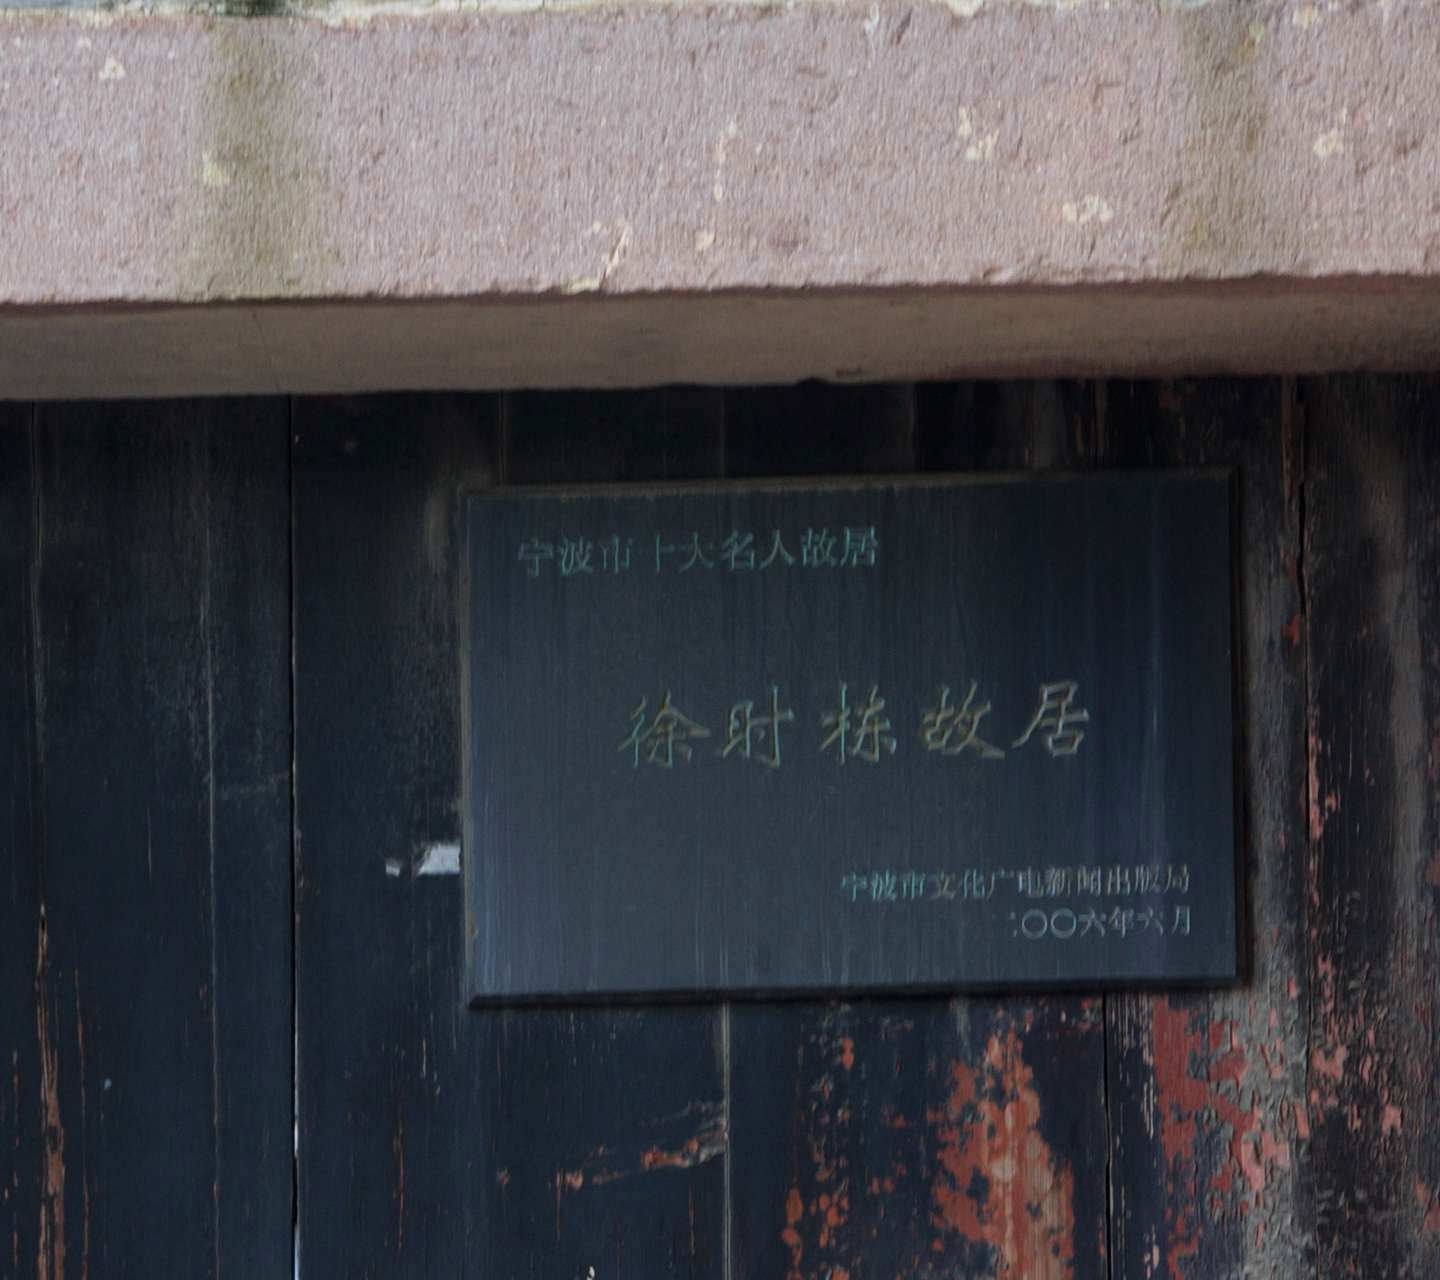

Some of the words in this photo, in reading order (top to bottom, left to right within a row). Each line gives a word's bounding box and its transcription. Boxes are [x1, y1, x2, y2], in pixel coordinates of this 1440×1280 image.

[518, 526, 877, 577] 宁波市十大名人故居
[619, 680, 1090, 769] 徐时栋故居
[840, 864, 1190, 904] 宁波市文化广电新闻出版局
